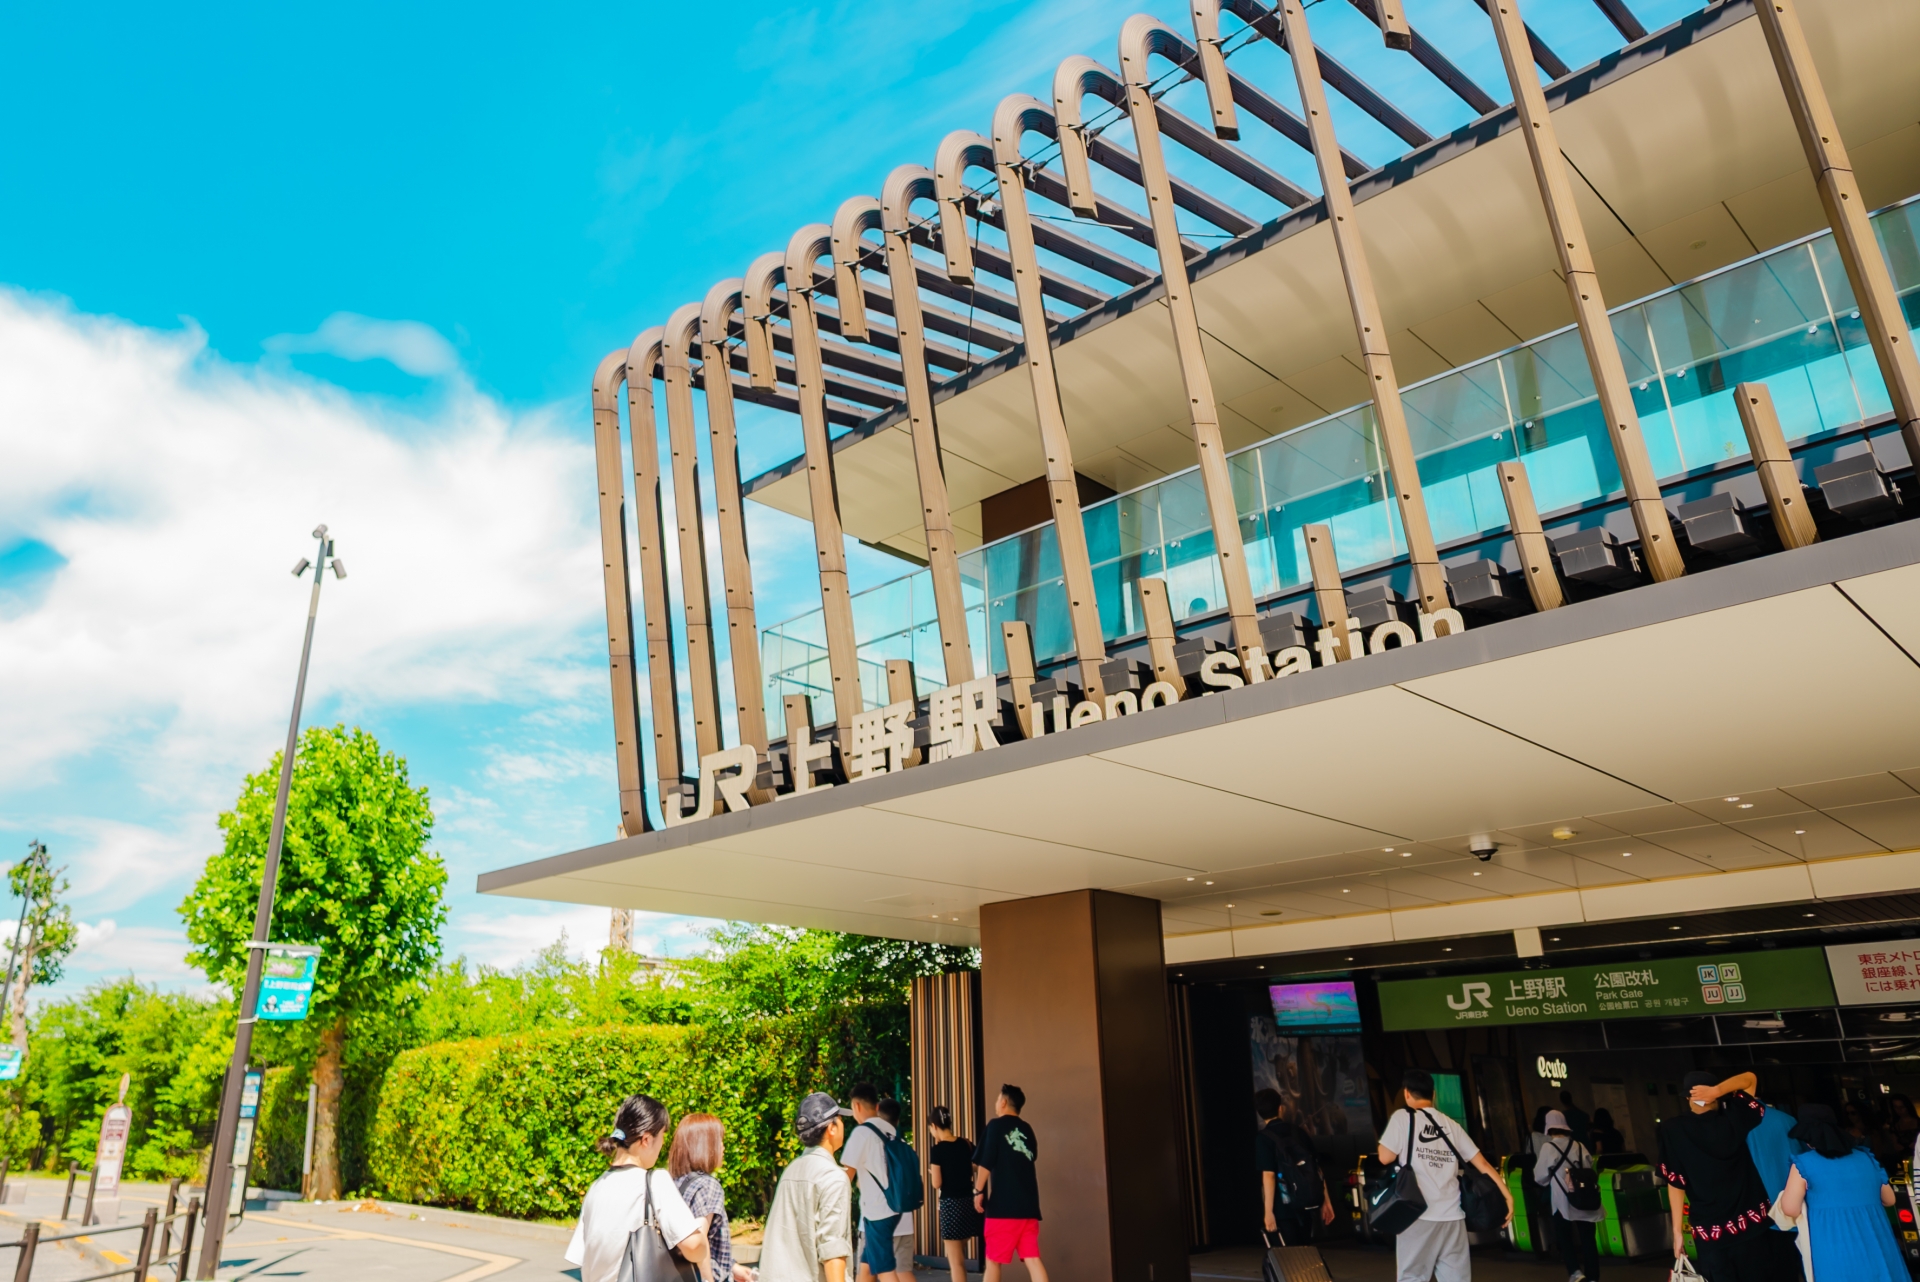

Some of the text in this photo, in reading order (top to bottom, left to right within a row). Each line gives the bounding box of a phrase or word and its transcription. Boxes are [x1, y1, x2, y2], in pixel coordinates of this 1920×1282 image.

[1200, 607, 1465, 697] Station
[1593, 969, 1659, 989] 公園改札
[1703, 968, 1735, 979] JK JY
[1504, 976, 1568, 1002] 上野駅
[1707, 988, 1739, 999] JU JJ
[1446, 981, 1494, 1011] JR
[1595, 989, 1644, 1001] Park Gate
[1505, 1001, 1588, 1017] Ueno Station
[1455, 1010, 1489, 1020] JR東日本
[1416, 1147, 1455, 1156] AUTHORIZED
[1417, 1153, 1455, 1163] PERSONNEL
[1428, 1161, 1444, 1169] ONLY
